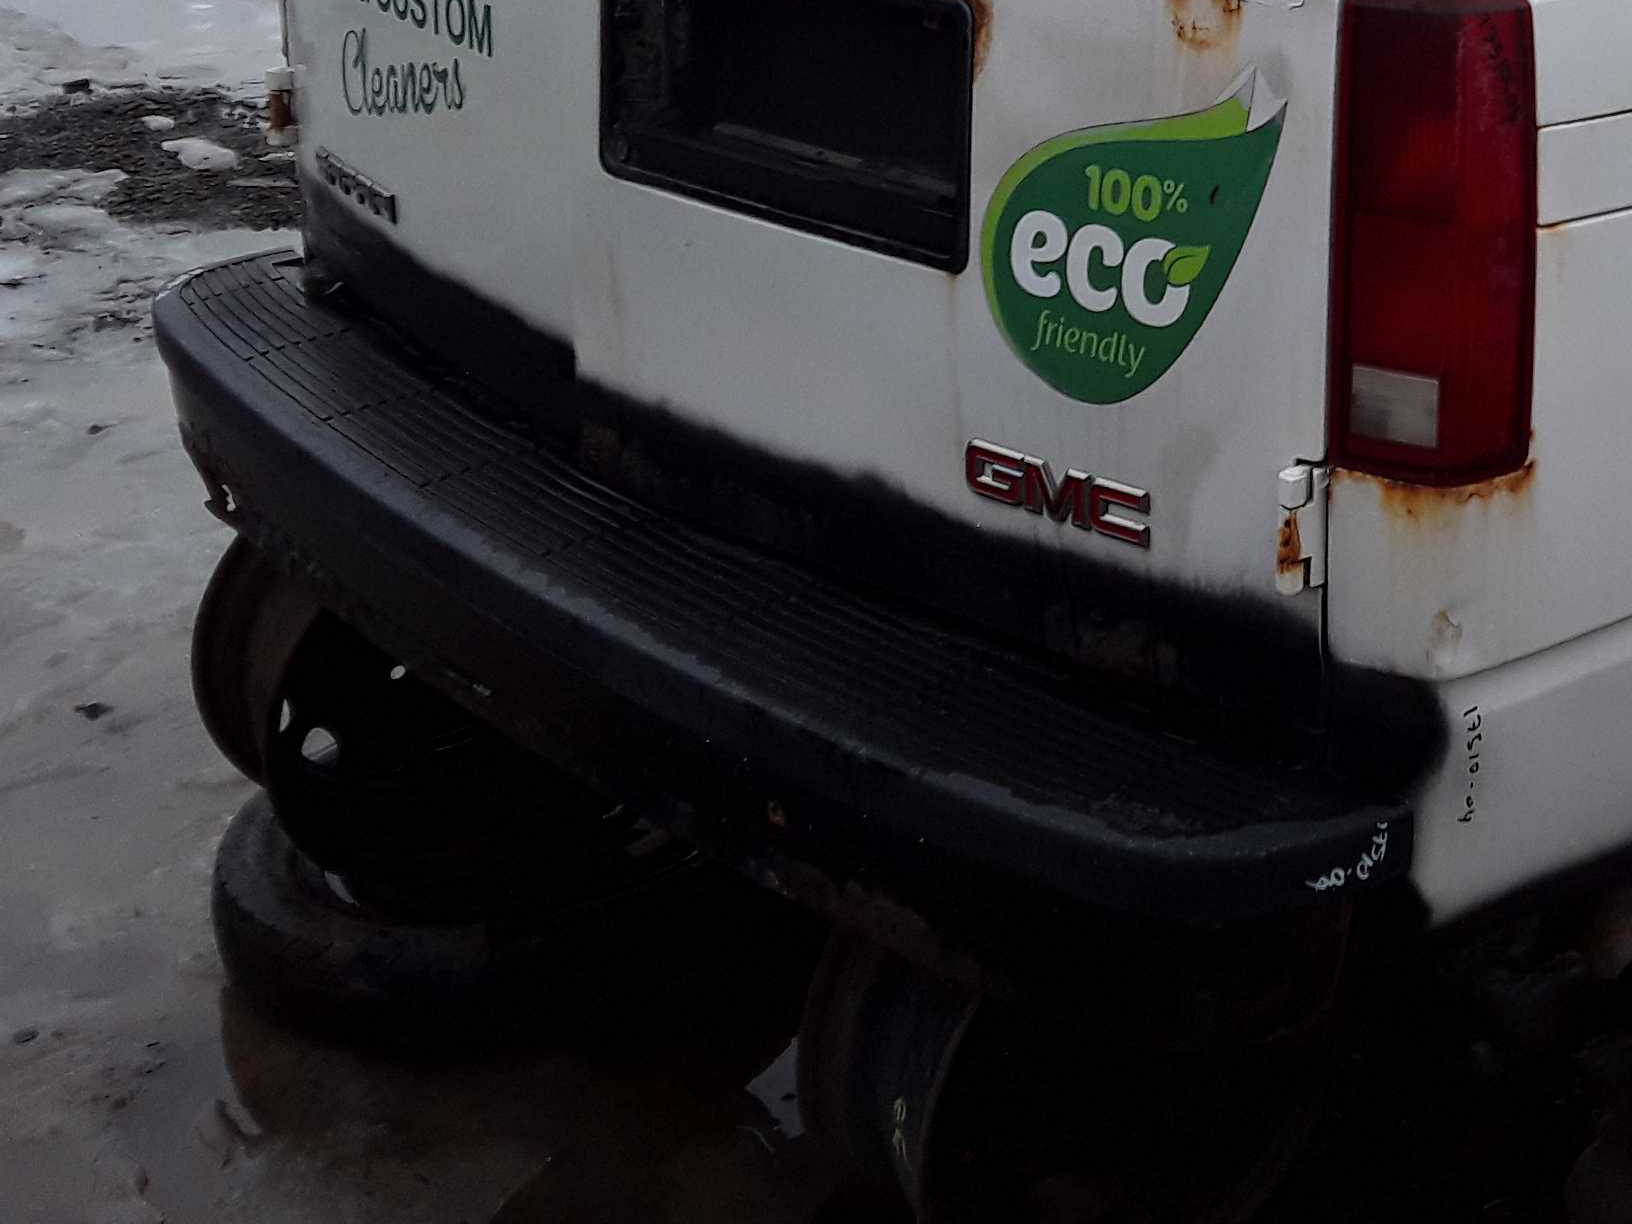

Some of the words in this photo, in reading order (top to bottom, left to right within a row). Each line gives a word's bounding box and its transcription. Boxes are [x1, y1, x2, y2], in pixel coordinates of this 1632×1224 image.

[342, 27, 465, 116] Cleaners
[1084, 164, 1189, 223] 100%
[1010, 209, 1195, 328] eco
[1030, 309, 1146, 378] friendly
[964, 437, 1151, 549] GMC
